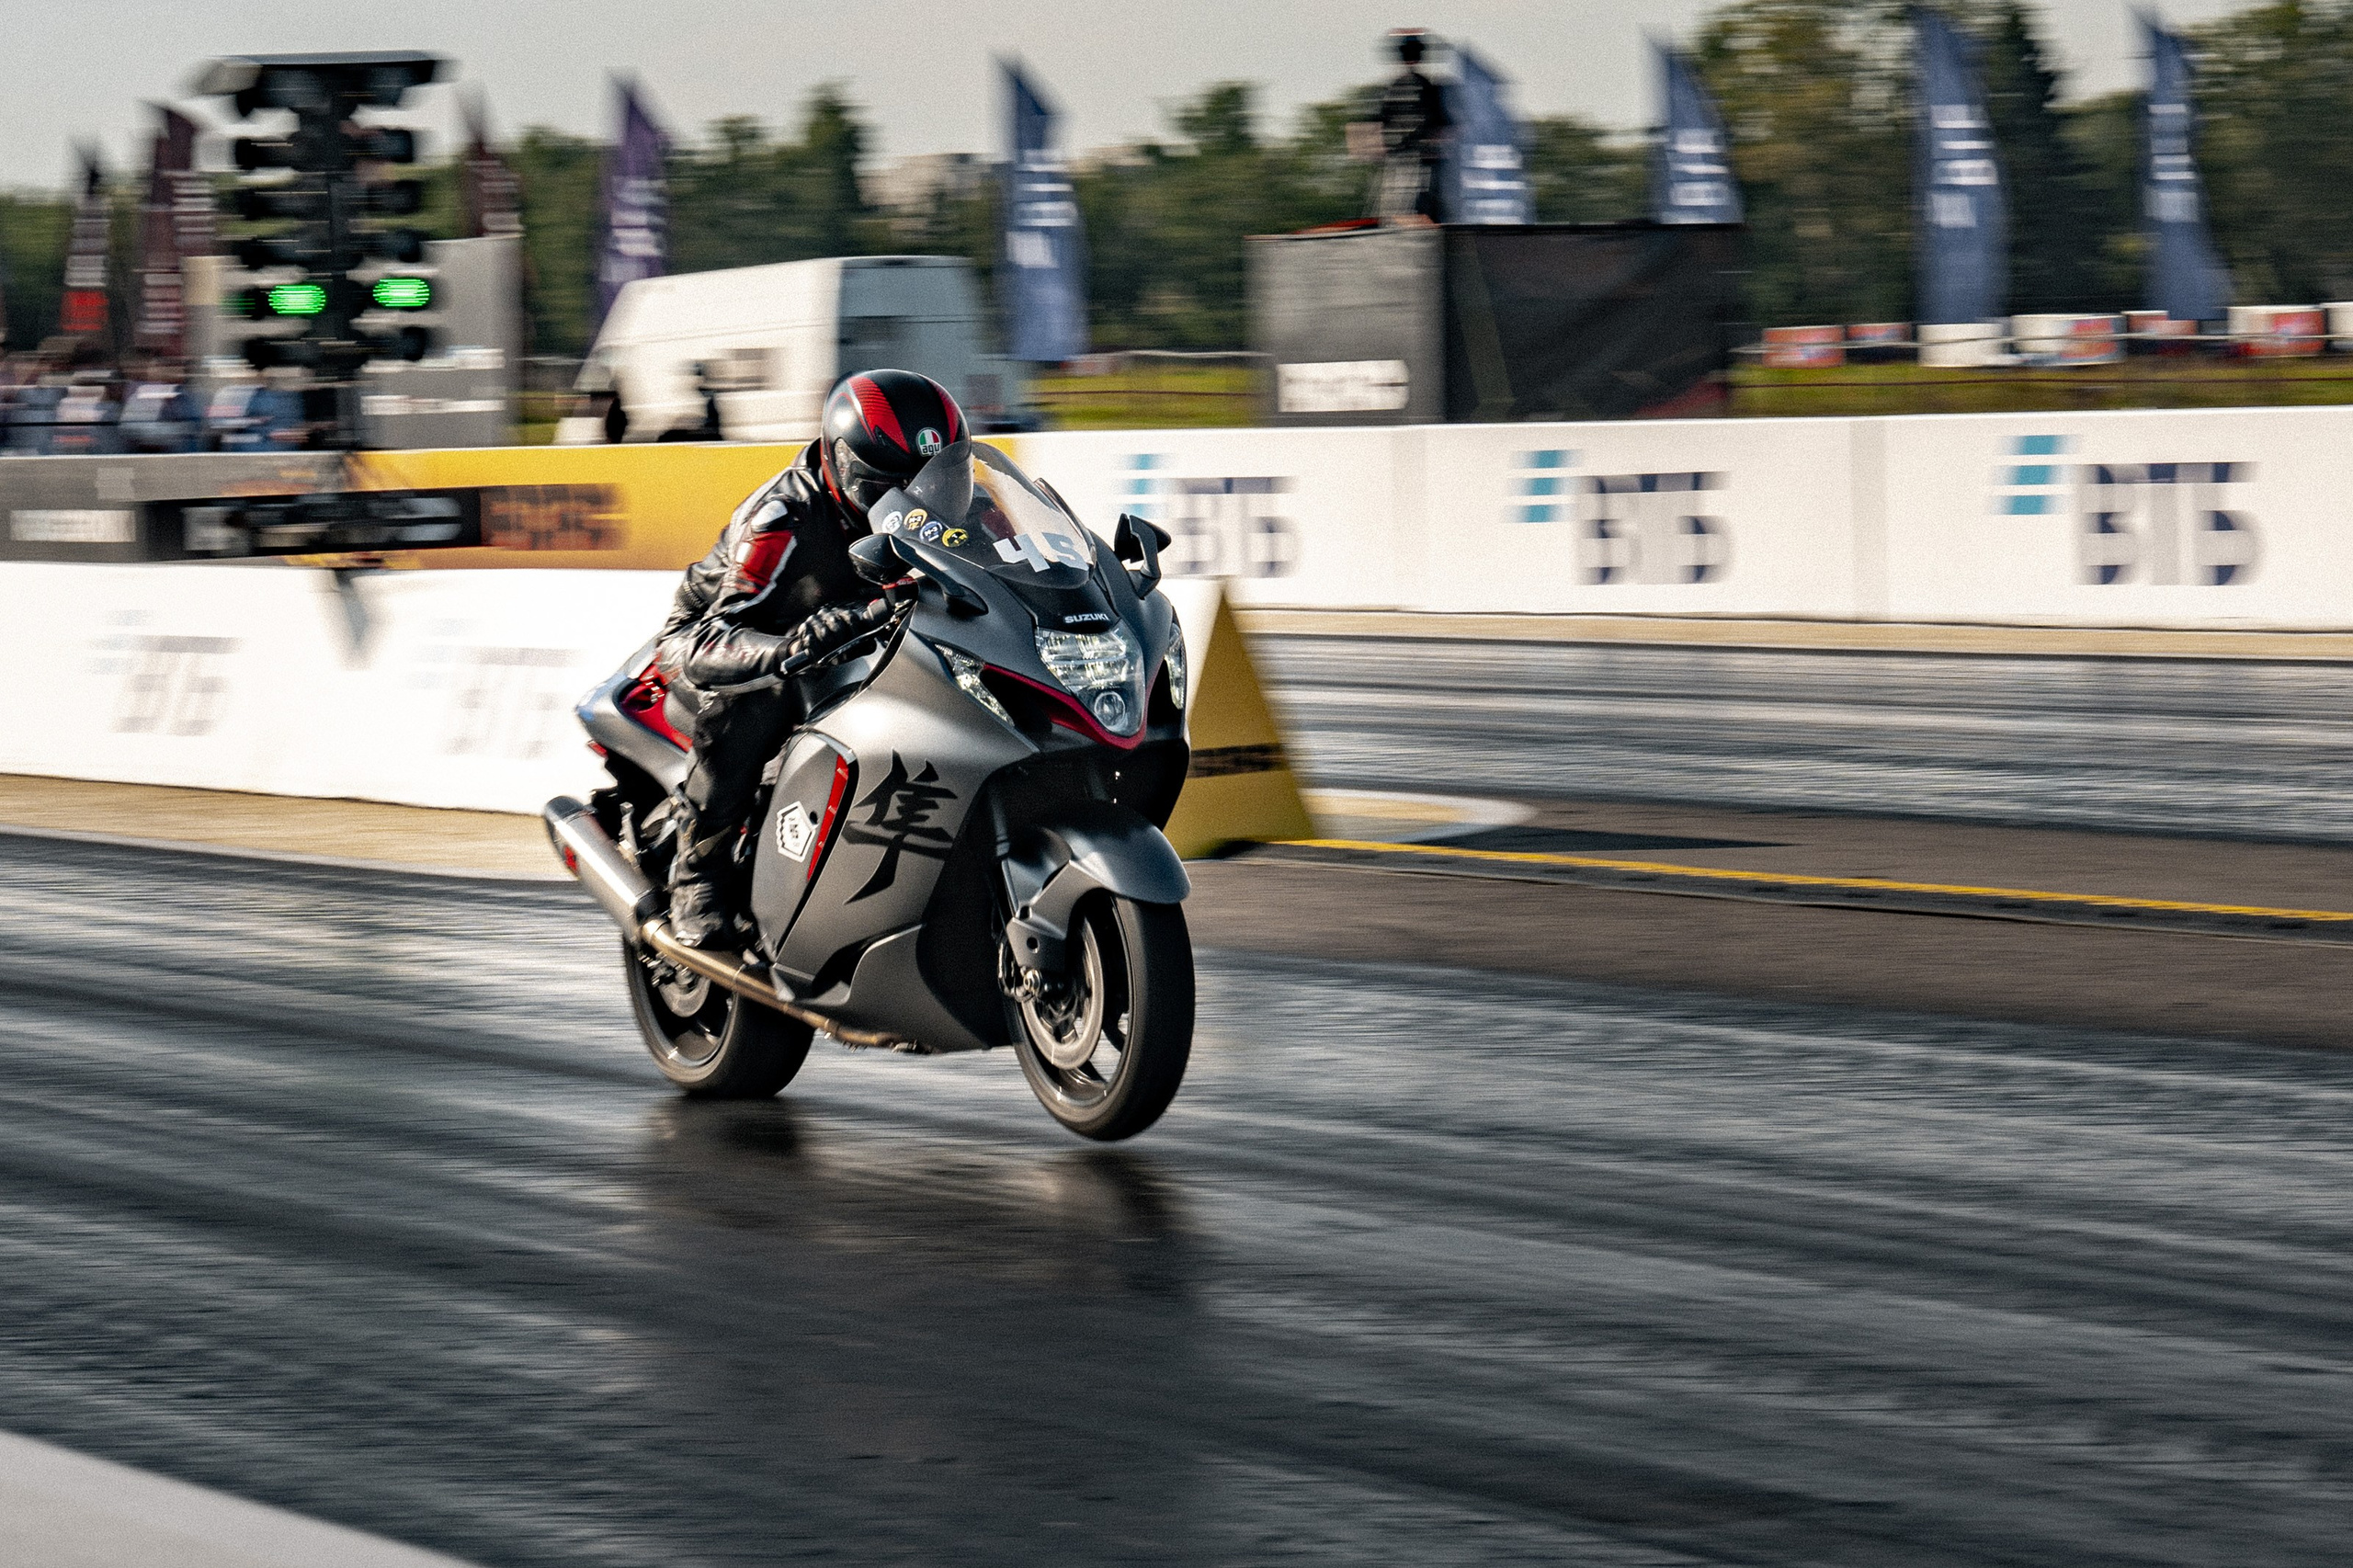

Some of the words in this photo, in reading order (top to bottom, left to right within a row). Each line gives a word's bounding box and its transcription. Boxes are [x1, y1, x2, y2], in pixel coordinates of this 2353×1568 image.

[922, 444, 939, 455] agv
[993, 532, 1089, 573] 45
[1064, 613, 1109, 624] SUZUKI
[840, 748, 958, 905] 隼
